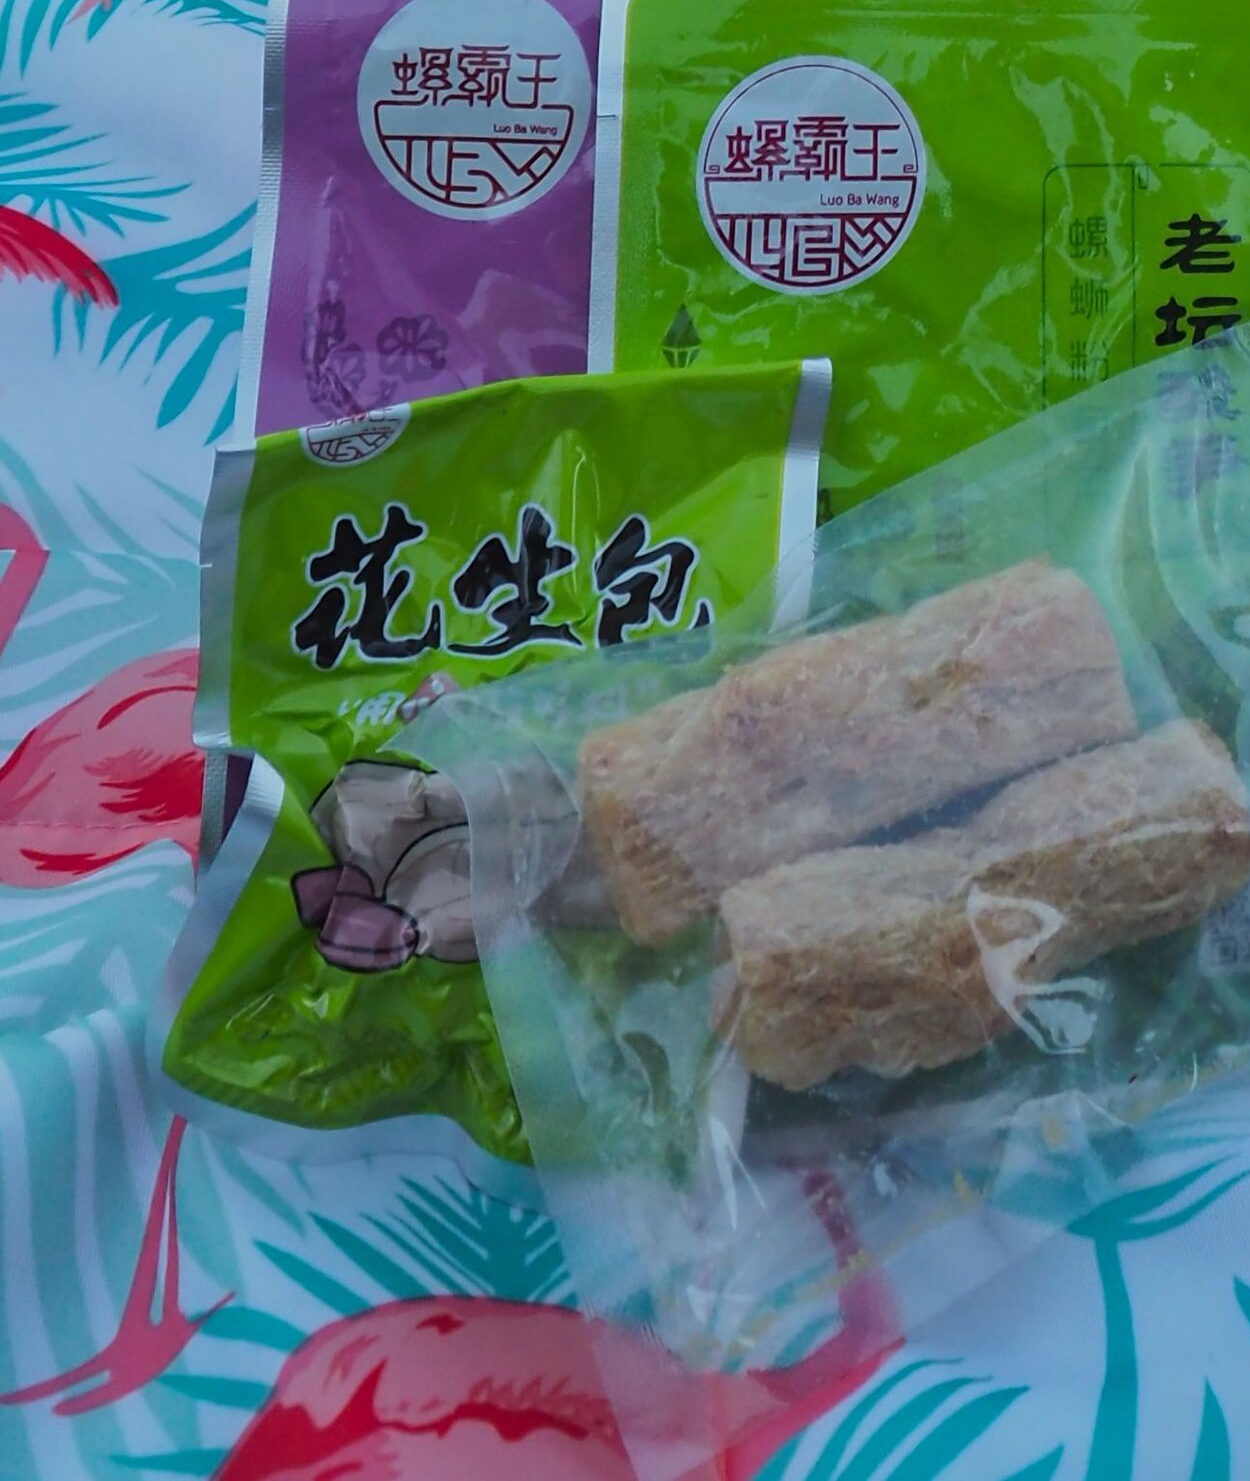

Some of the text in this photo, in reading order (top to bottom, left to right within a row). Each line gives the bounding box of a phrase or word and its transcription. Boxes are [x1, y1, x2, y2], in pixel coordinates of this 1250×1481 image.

[390, 45, 562, 107] 螺霸王
[494, 124, 558, 136] Luo Ba Wang
[724, 116, 902, 179] 螺霸王
[819, 193, 900, 208] Luo Ba Wang
[291, 501, 714, 670] 花生包
